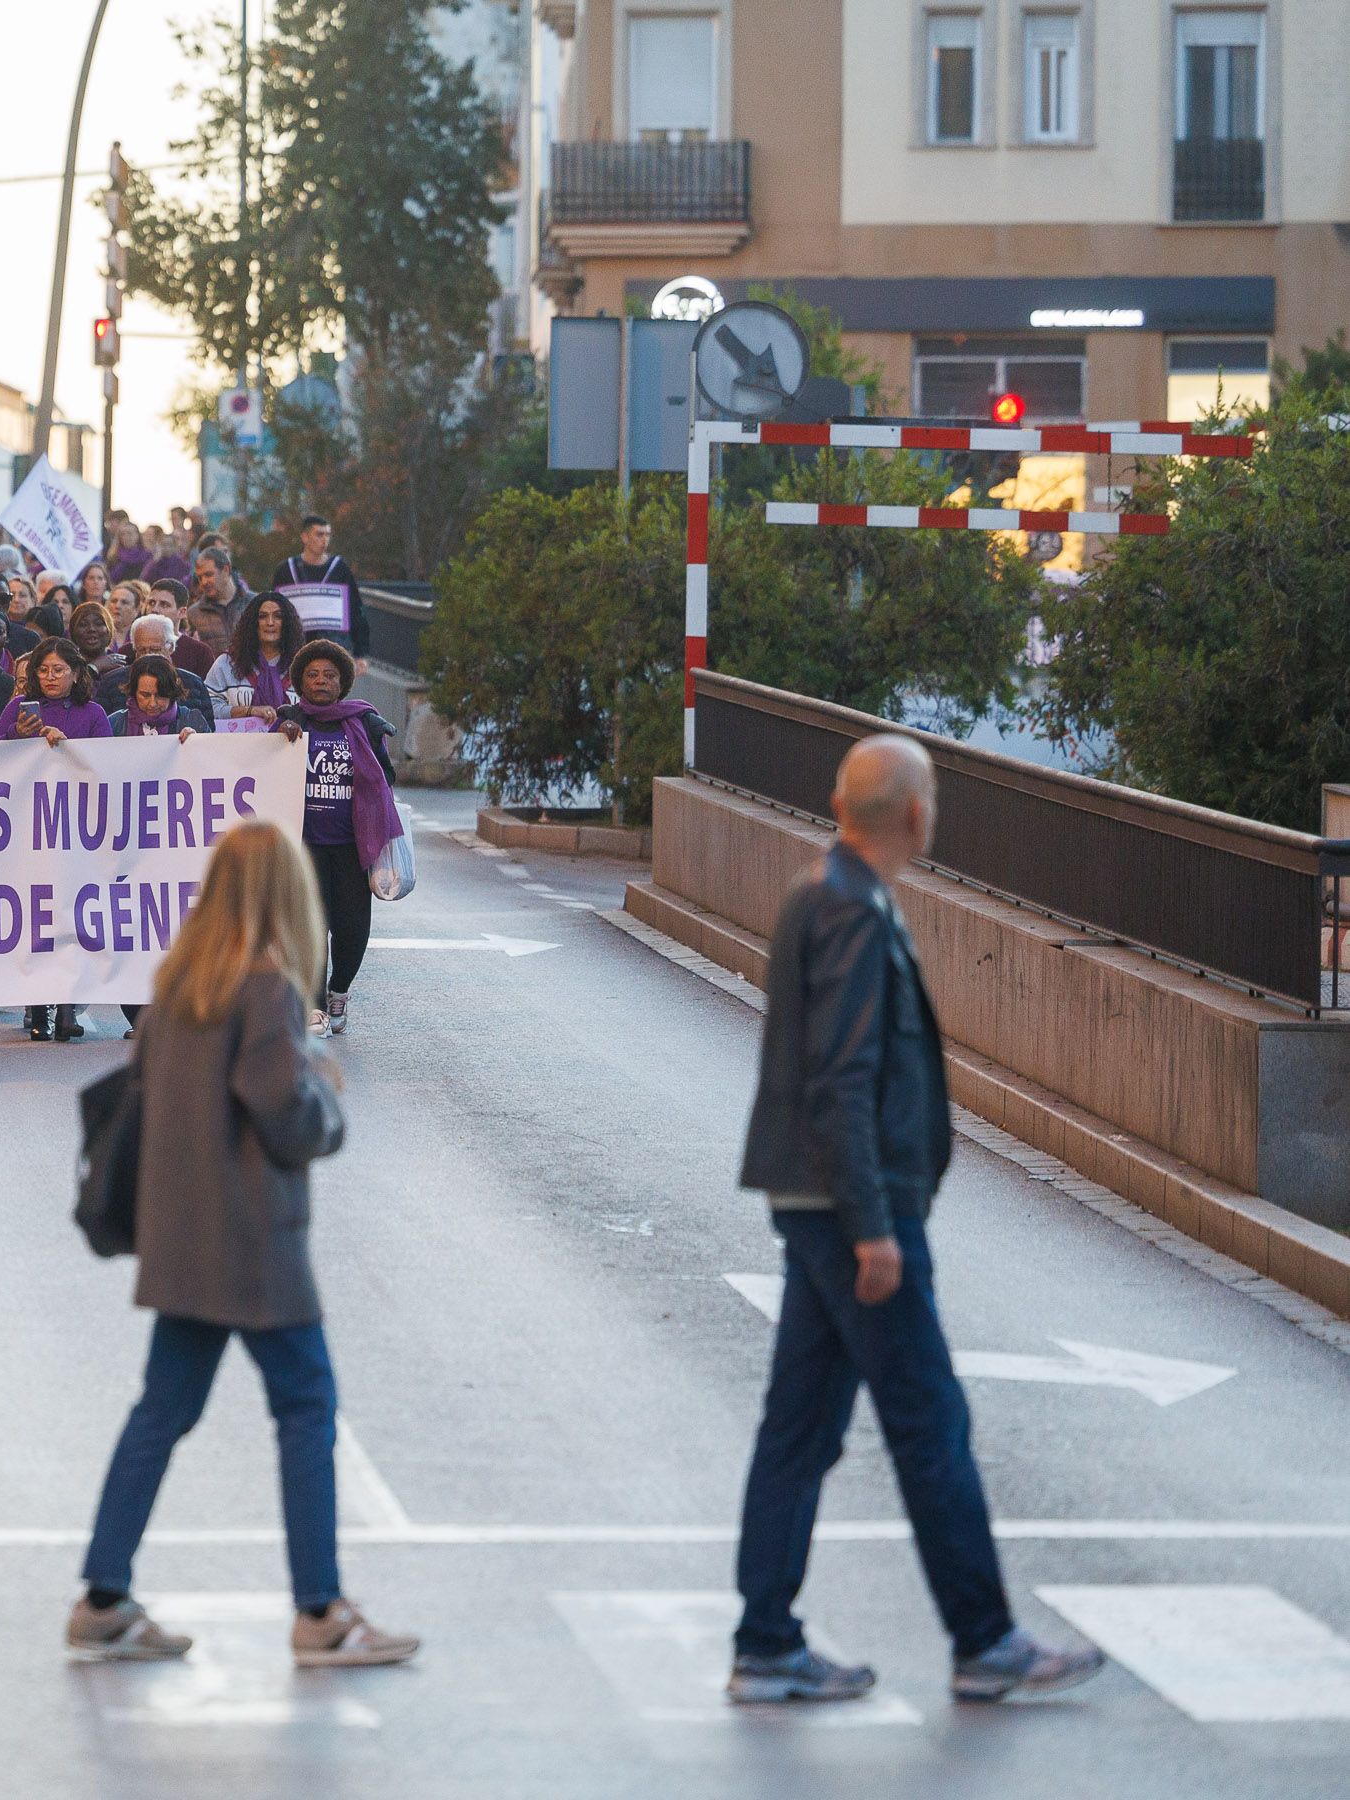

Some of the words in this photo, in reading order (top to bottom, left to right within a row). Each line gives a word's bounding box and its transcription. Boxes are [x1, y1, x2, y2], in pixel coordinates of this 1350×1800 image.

[318, 774, 340, 783] nos
[306, 783, 354, 799] UEREMO
[32, 776, 256, 851] MUJERES
